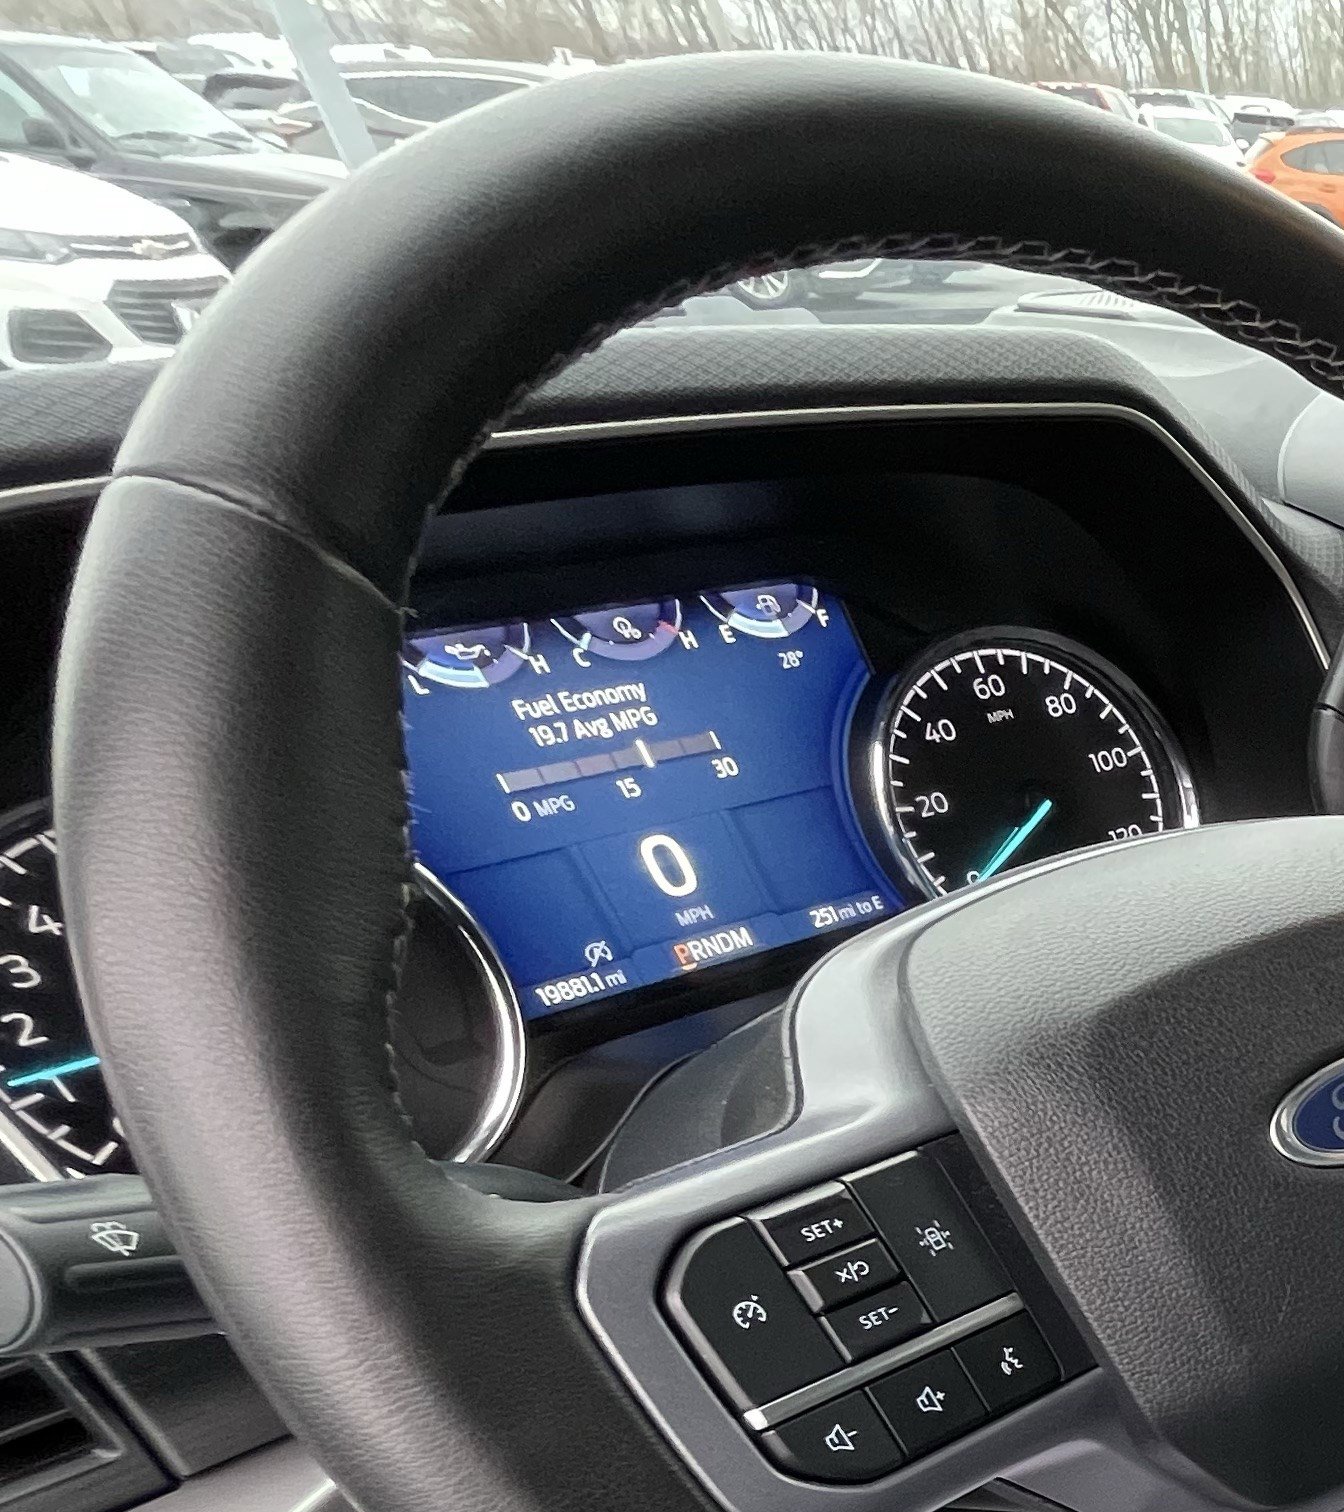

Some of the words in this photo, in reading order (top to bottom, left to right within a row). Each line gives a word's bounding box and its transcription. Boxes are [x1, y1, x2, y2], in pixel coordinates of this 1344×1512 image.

[816, 608, 830, 628] F
[678, 629, 700, 650] H
[718, 623, 737, 644] E
[528, 653, 551, 675] H
[572, 647, 592, 668] C
[408, 674, 430, 695] L
[972, 674, 1006, 700] 60
[511, 694, 562, 721] Fuel
[556, 682, 647, 713] Economy
[1044, 692, 1077, 718] 80
[528, 721, 569, 747] 19.7
[572, 717, 614, 739] Avg
[608, 706, 659, 732] MPG
[986, 708, 1014, 724] MPH
[924, 718, 957, 743] 40
[711, 756, 740, 779] 30
[1088, 747, 1128, 773] 100
[615, 777, 642, 799] 15
[511, 800, 532, 822] 0
[532, 795, 576, 818] MPG
[915, 791, 949, 818] 20
[640, 834, 698, 898] 0
[28, 904, 64, 936] 4
[674, 904, 715, 927] MPH
[809, 906, 841, 929] 251
[839, 902, 858, 921] mi
[872, 895, 885, 910] E
[0, 954, 41, 988] 3
[534, 972, 606, 1007] 19881.1
[604, 969, 628, 989] mi
[0, 1013, 49, 1047] 2
